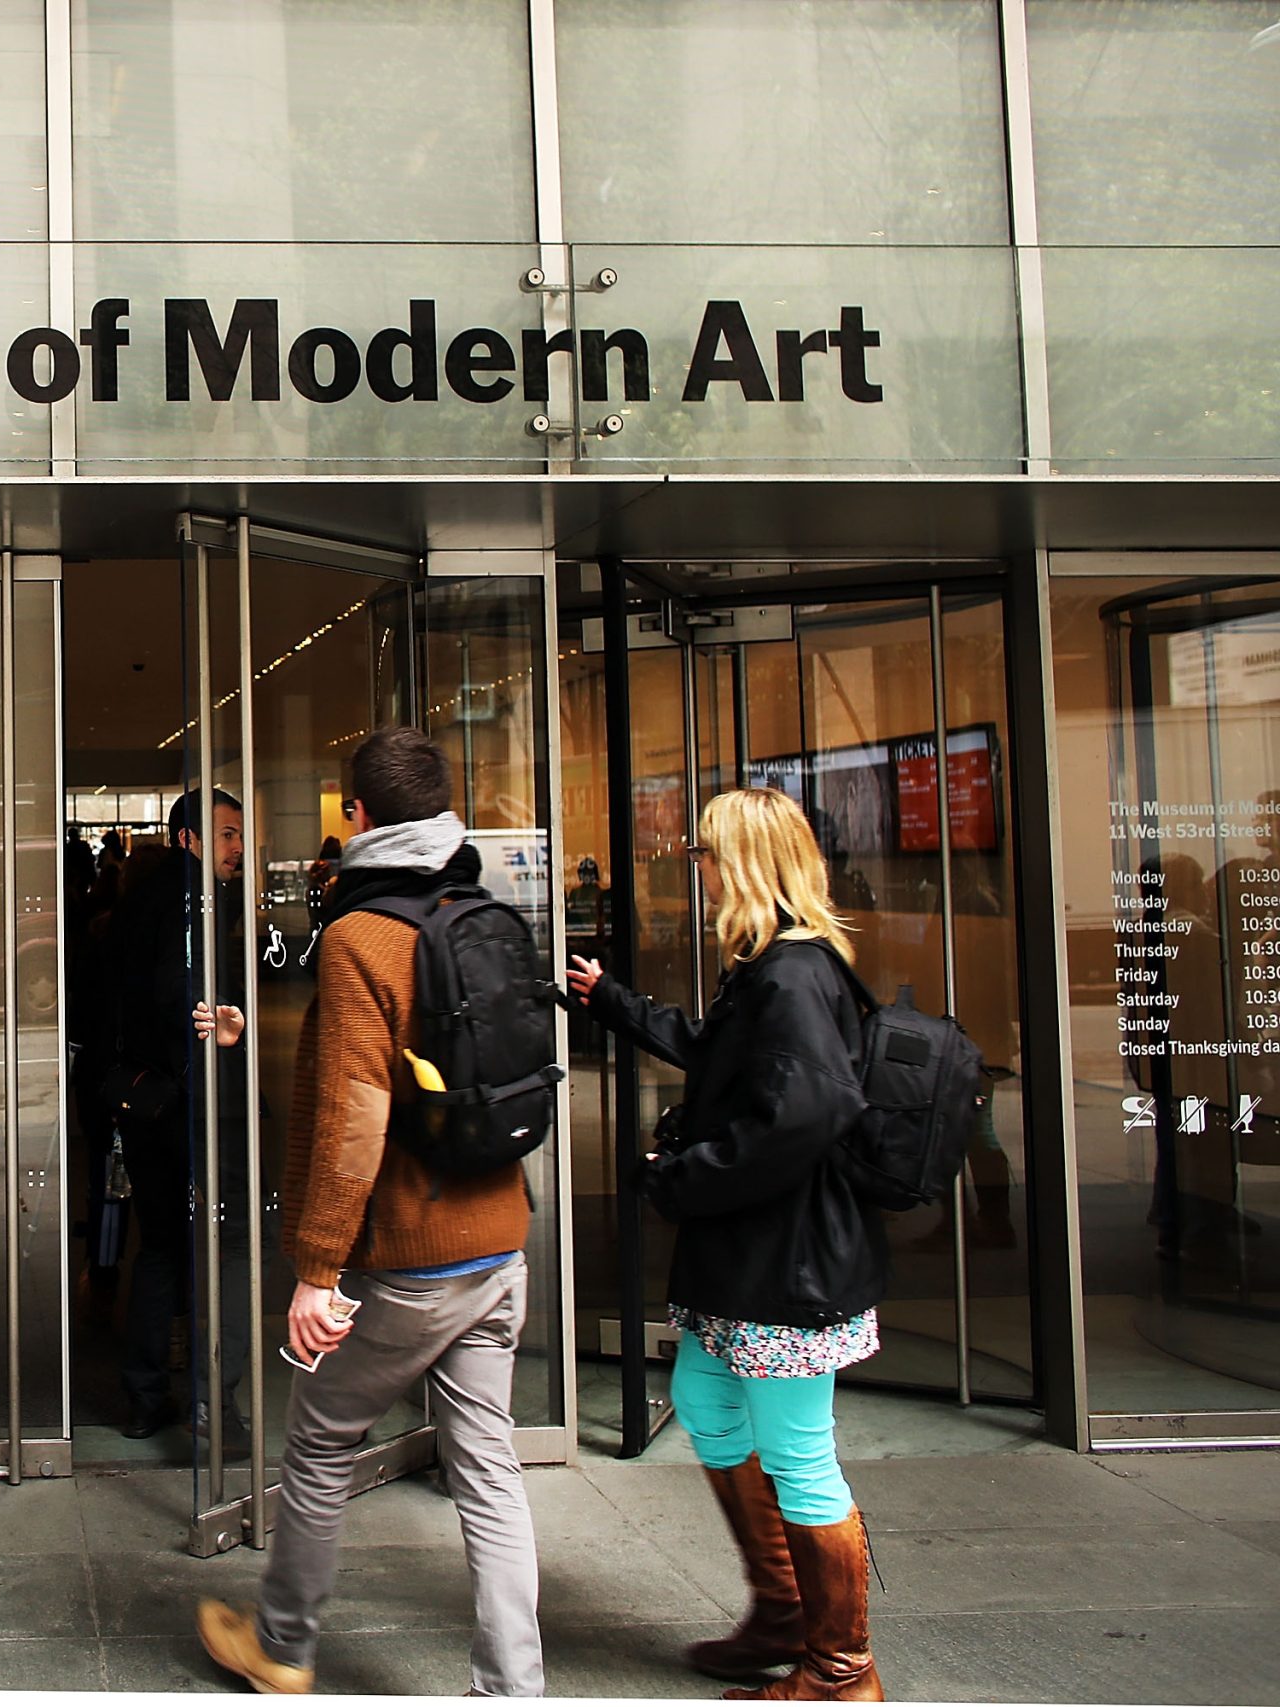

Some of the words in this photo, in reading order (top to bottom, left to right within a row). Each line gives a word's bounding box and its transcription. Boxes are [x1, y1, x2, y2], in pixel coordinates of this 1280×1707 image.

[6, 299, 130, 403] of
[164, 299, 650, 403] Modern
[681, 299, 883, 404] Art
[1109, 802, 1139, 817] The
[1144, 801, 1214, 817] Museum
[1219, 800, 1236, 816] of
[1110, 824, 1127, 839] 11
[1130, 823, 1171, 839] West
[1176, 823, 1216, 838] 53rd
[1220, 822, 1271, 838] Street
[1111, 870, 1166, 886] Monday
[1239, 869, 1280, 883] 10:30
[1112, 894, 1169, 911] Tuesday
[1113, 919, 1192, 935] Wednesday
[1114, 943, 1179, 959] Thursday
[1115, 967, 1158, 984] Friday
[1116, 992, 1180, 1009] Saturday
[1118, 1017, 1170, 1033] Sunday
[1246, 1015, 1280, 1029] 10:3
[1118, 1041, 1165, 1056] Closed
[1168, 1040, 1260, 1057] Thanksgiving
